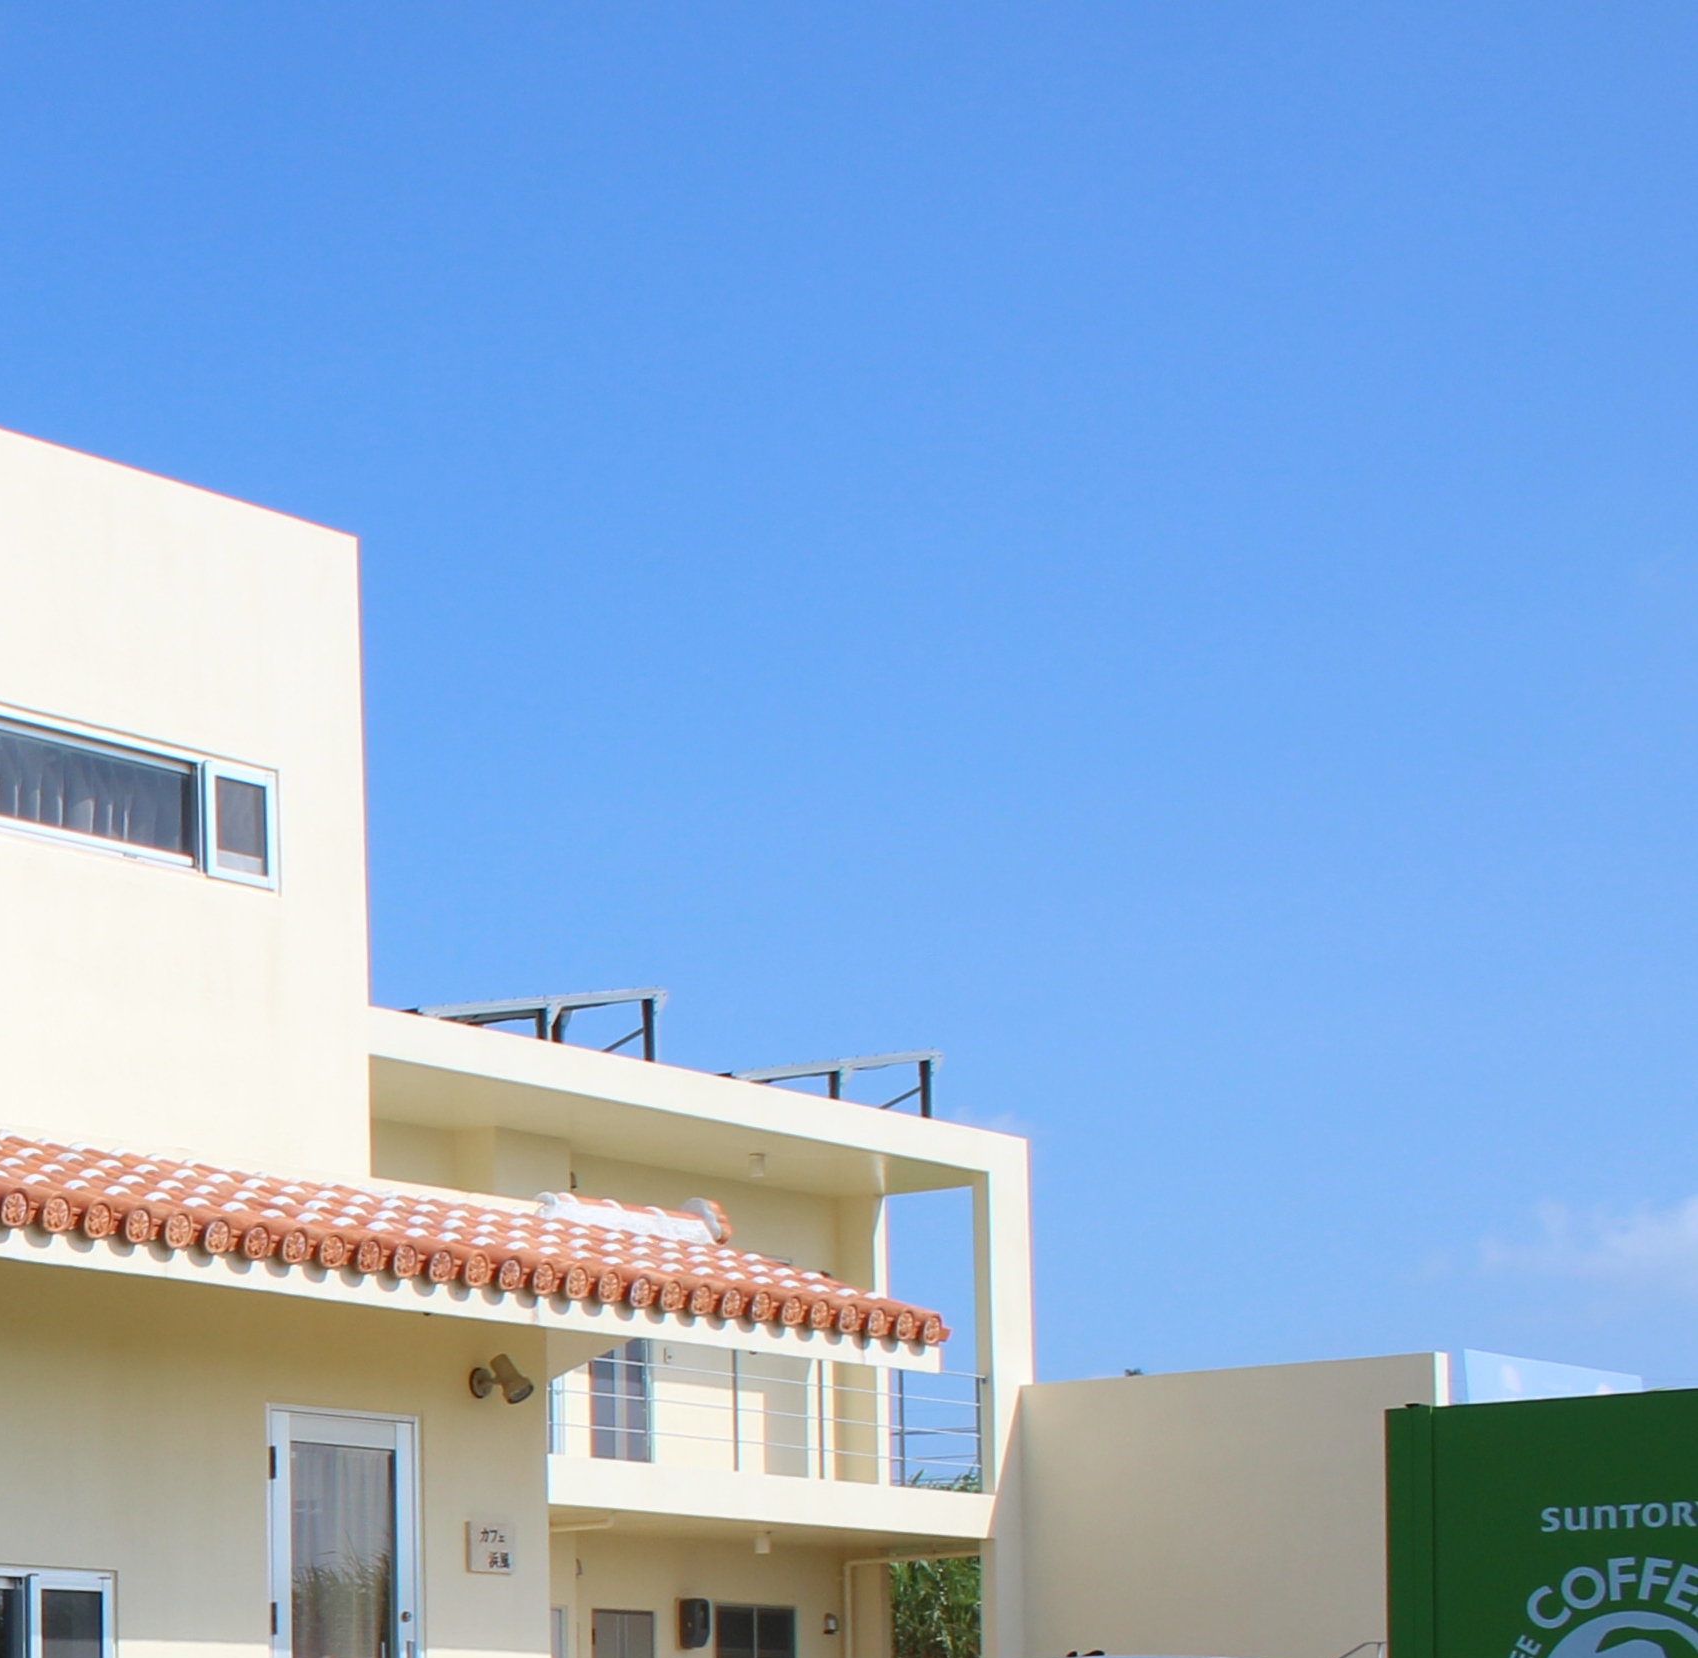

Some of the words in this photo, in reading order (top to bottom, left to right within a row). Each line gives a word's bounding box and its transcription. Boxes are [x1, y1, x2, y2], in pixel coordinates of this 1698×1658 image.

[1540, 1501, 1698, 1532] SUNTOR
[479, 1528, 506, 1543] カフェ
[1526, 1556, 1698, 1629] COFFE
